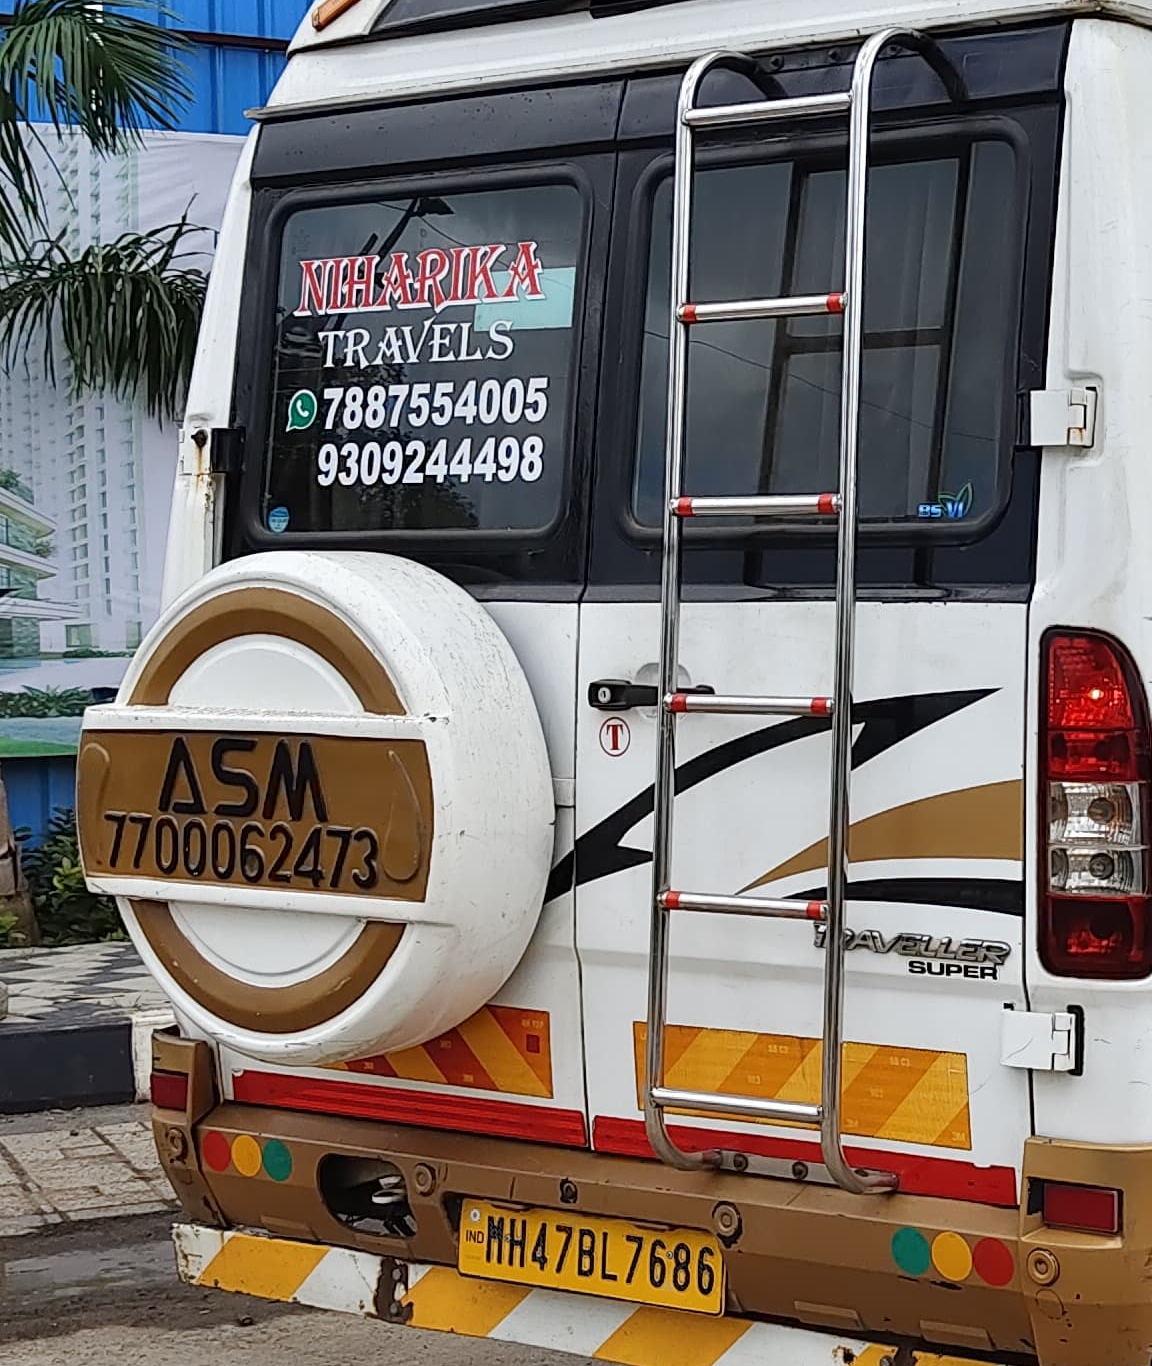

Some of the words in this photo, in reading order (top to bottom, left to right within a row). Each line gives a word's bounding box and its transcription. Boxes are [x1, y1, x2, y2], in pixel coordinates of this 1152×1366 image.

[293, 241, 547, 317] NIHARIKA
[317, 316, 515, 370] TRAVELS
[323, 376, 549, 430] 7887554005
[317, 435, 545, 487] 9309244498
[918, 504, 942, 518] BS
[946, 501, 965, 519] VI
[606, 724, 624, 751] T
[157, 736, 329, 823] ASM
[104, 810, 379, 890] 7700062473
[908, 960, 998, 980] SUPER
[465, 1229, 485, 1244] IND
[485, 1215, 715, 1296] MH47BL7686
